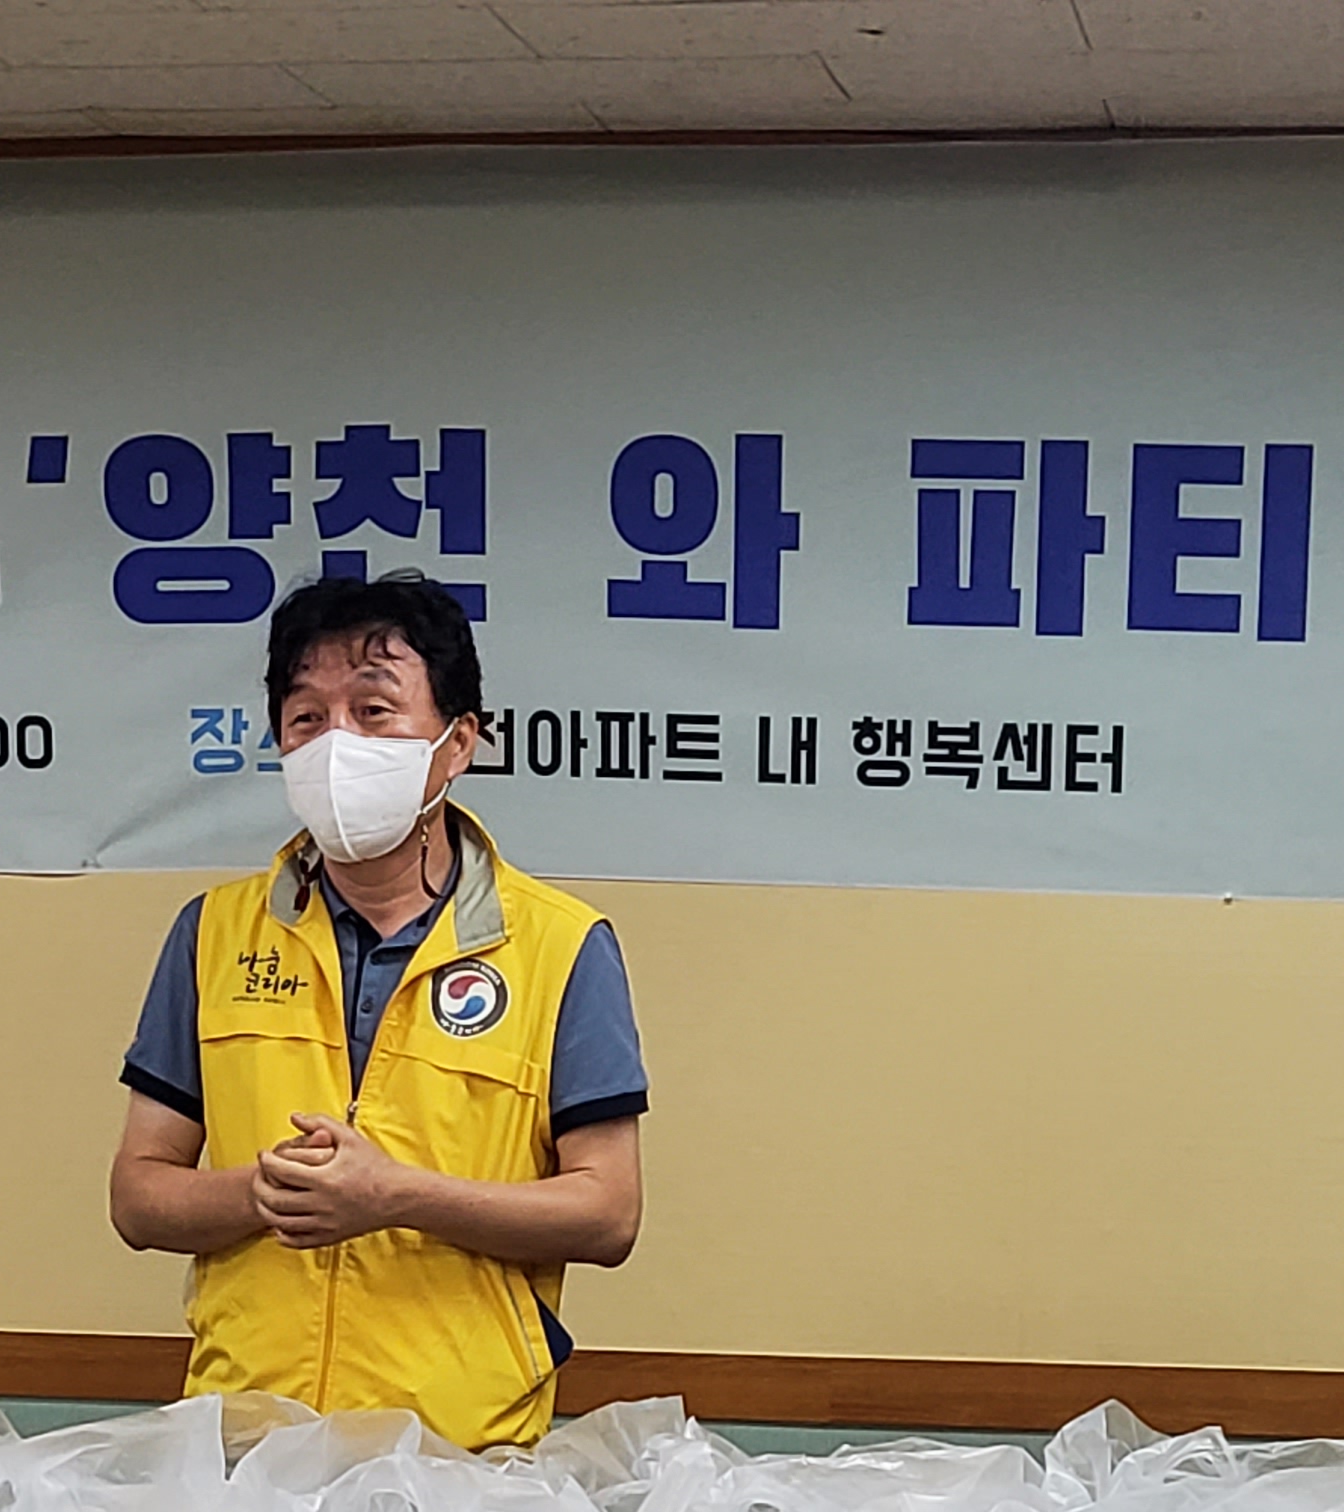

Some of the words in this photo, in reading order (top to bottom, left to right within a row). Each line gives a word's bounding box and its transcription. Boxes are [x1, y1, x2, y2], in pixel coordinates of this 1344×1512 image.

[606, 432, 801, 629] 와
[756, 712, 819, 789] 내
[849, 716, 1127, 795] 행복센터
